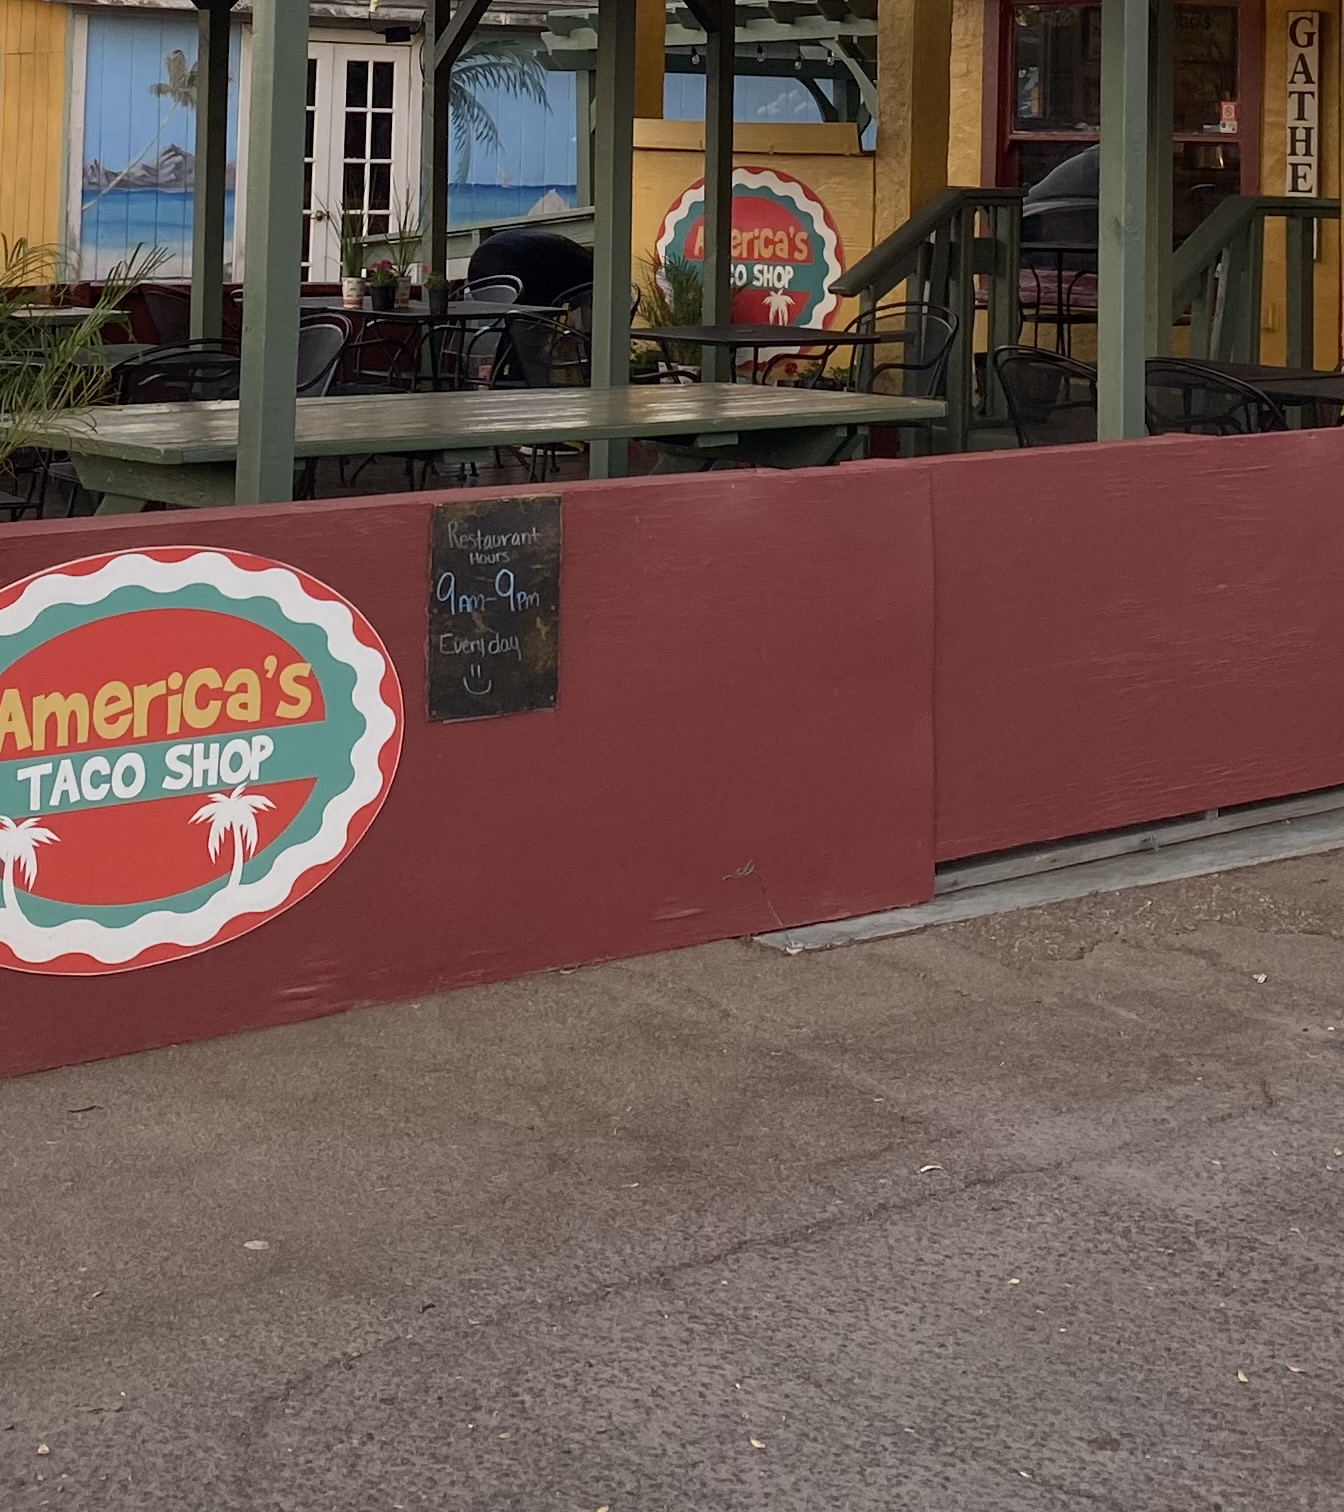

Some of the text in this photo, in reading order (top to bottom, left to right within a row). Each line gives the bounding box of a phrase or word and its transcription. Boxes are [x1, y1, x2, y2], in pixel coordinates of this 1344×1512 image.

[1287, 16, 1317, 194] GATHE
[693, 225, 809, 261] Aerica's
[752, 263, 794, 289] SHOP
[448, 520, 540, 549] Restaurant
[469, 551, 511, 565] Hours
[17, 735, 275, 812] TACO SHOP
